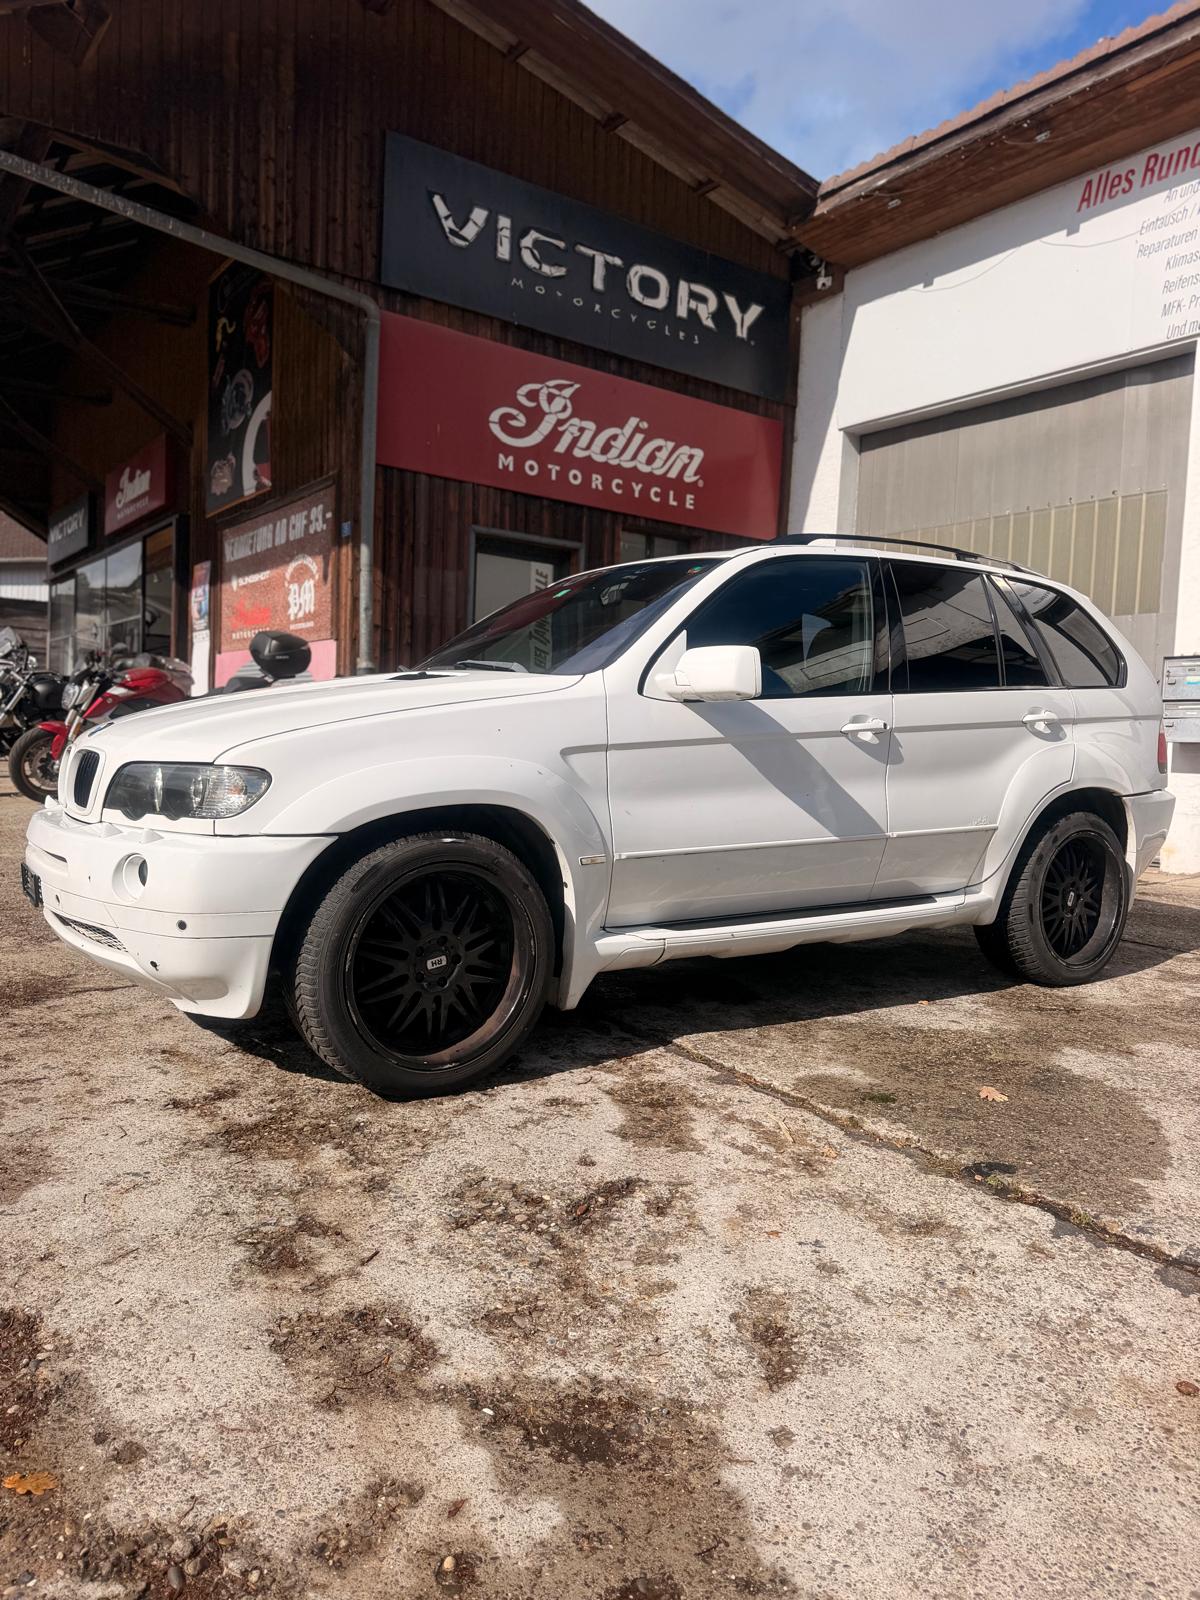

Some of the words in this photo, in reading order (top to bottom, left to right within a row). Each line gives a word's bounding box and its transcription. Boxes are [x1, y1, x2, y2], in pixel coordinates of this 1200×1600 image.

[1076, 168, 1136, 213] Alles
[1163, 189, 1178, 203] An
[1139, 205, 1189, 236] Eintausch
[1137, 228, 1198, 259] Reparaturen
[429, 191, 764, 341] VICTORY
[1165, 249, 1200, 271] Klimas
[1162, 273, 1200, 294] Reifens
[1167, 319, 1188, 340] Und
[488, 379, 704, 485] Indian
[497, 453, 695, 510] MOTORCYCLE
[49, 507, 85, 544] VICTORY
